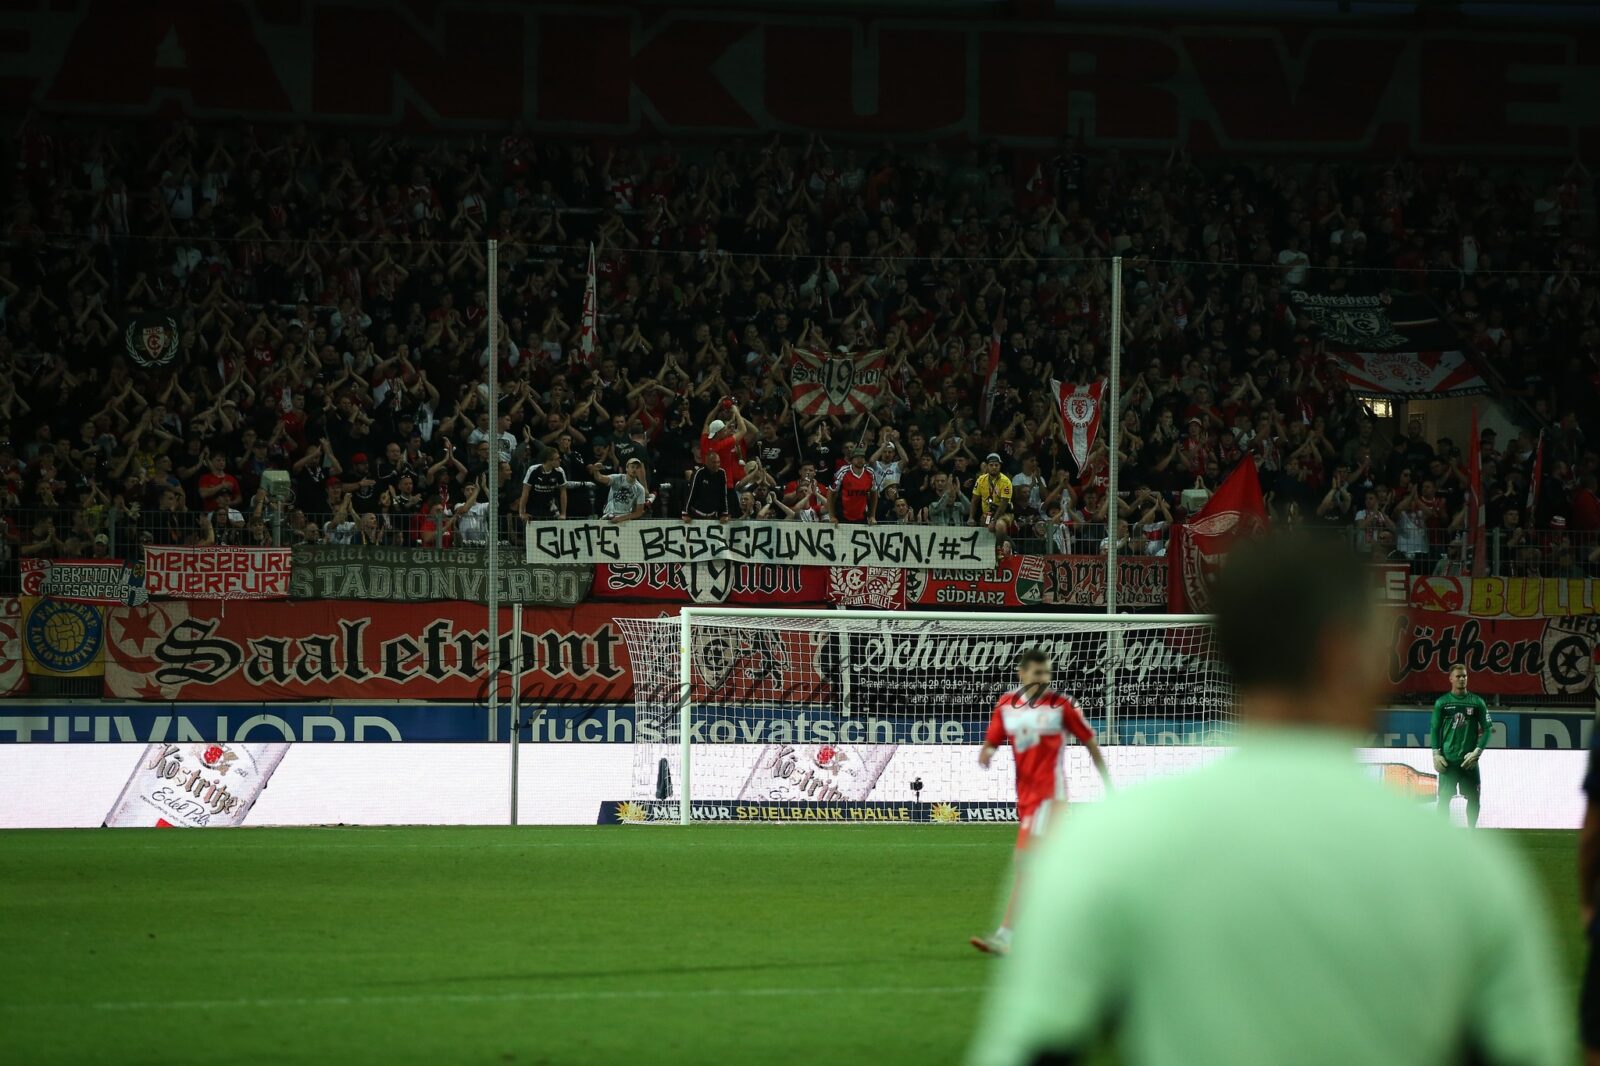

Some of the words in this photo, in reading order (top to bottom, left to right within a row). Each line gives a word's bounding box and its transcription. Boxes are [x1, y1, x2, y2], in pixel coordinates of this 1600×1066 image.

[850, 529, 937, 565] SVEN!
[938, 530, 982, 562] #1
[52, 567, 121, 583] SEKTION
[931, 568, 1013, 583] MANSFELD
[936, 585, 1005, 604] SÜDHARZ
[1468, 576, 1600, 618] BULL
[155, 617, 626, 685] Saalefront
[151, 787, 186, 814] Edel
[653, 806, 731, 820] MEKUR
[735, 807, 843, 820] SPIELBANK
[849, 807, 912, 820] HALLE
[966, 808, 1019, 820] MERK
